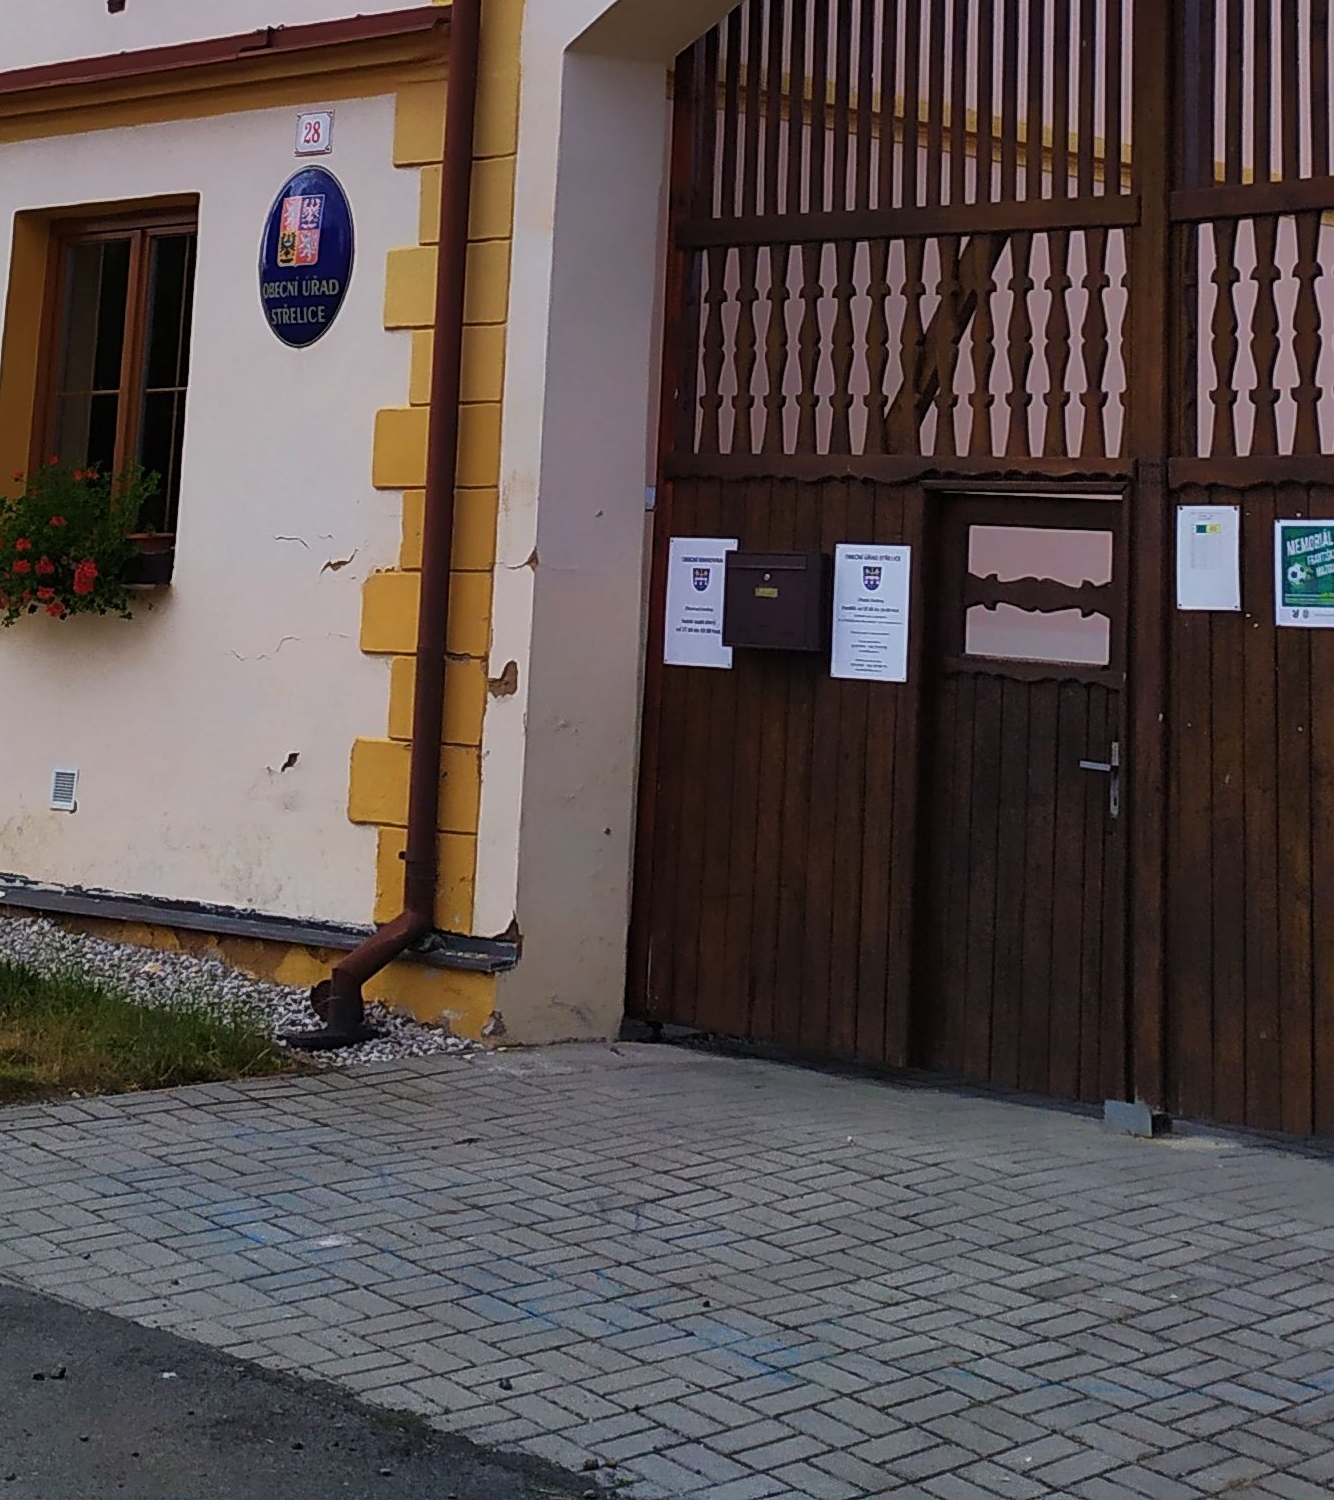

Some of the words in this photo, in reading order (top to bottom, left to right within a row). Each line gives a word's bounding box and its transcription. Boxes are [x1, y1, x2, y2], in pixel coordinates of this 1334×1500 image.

[303, 121, 321, 144] 28
[263, 276, 300, 298] OBECNÍ
[302, 275, 339, 297] ÚŘAD
[271, 304, 326, 325] STŘELICE
[1286, 528, 1334, 557] MEMORIÁL
